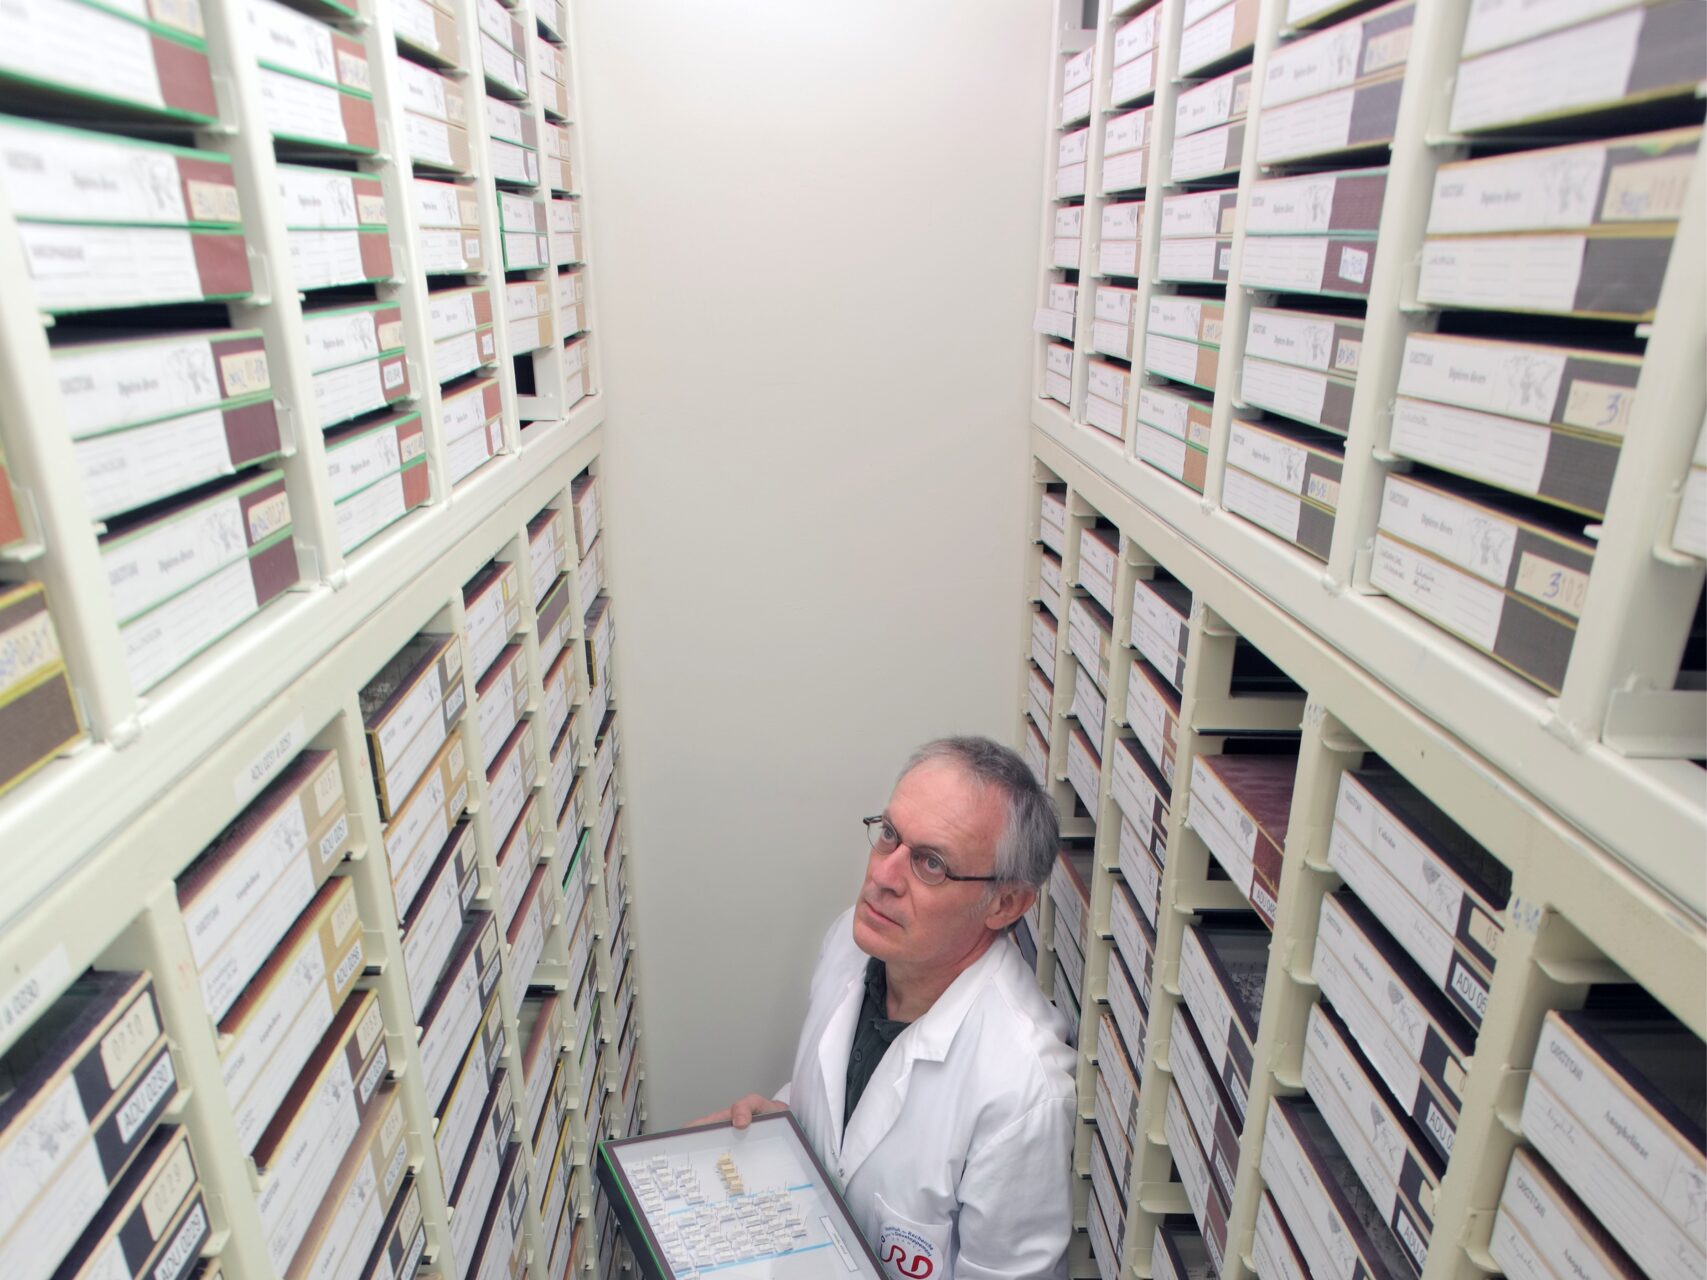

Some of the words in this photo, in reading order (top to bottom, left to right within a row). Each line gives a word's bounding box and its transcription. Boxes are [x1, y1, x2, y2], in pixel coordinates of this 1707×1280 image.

[1455, 968, 1477, 999] ADU
[1428, 1107, 1448, 1142] ADU
[1403, 1221, 1420, 1257] ADU
